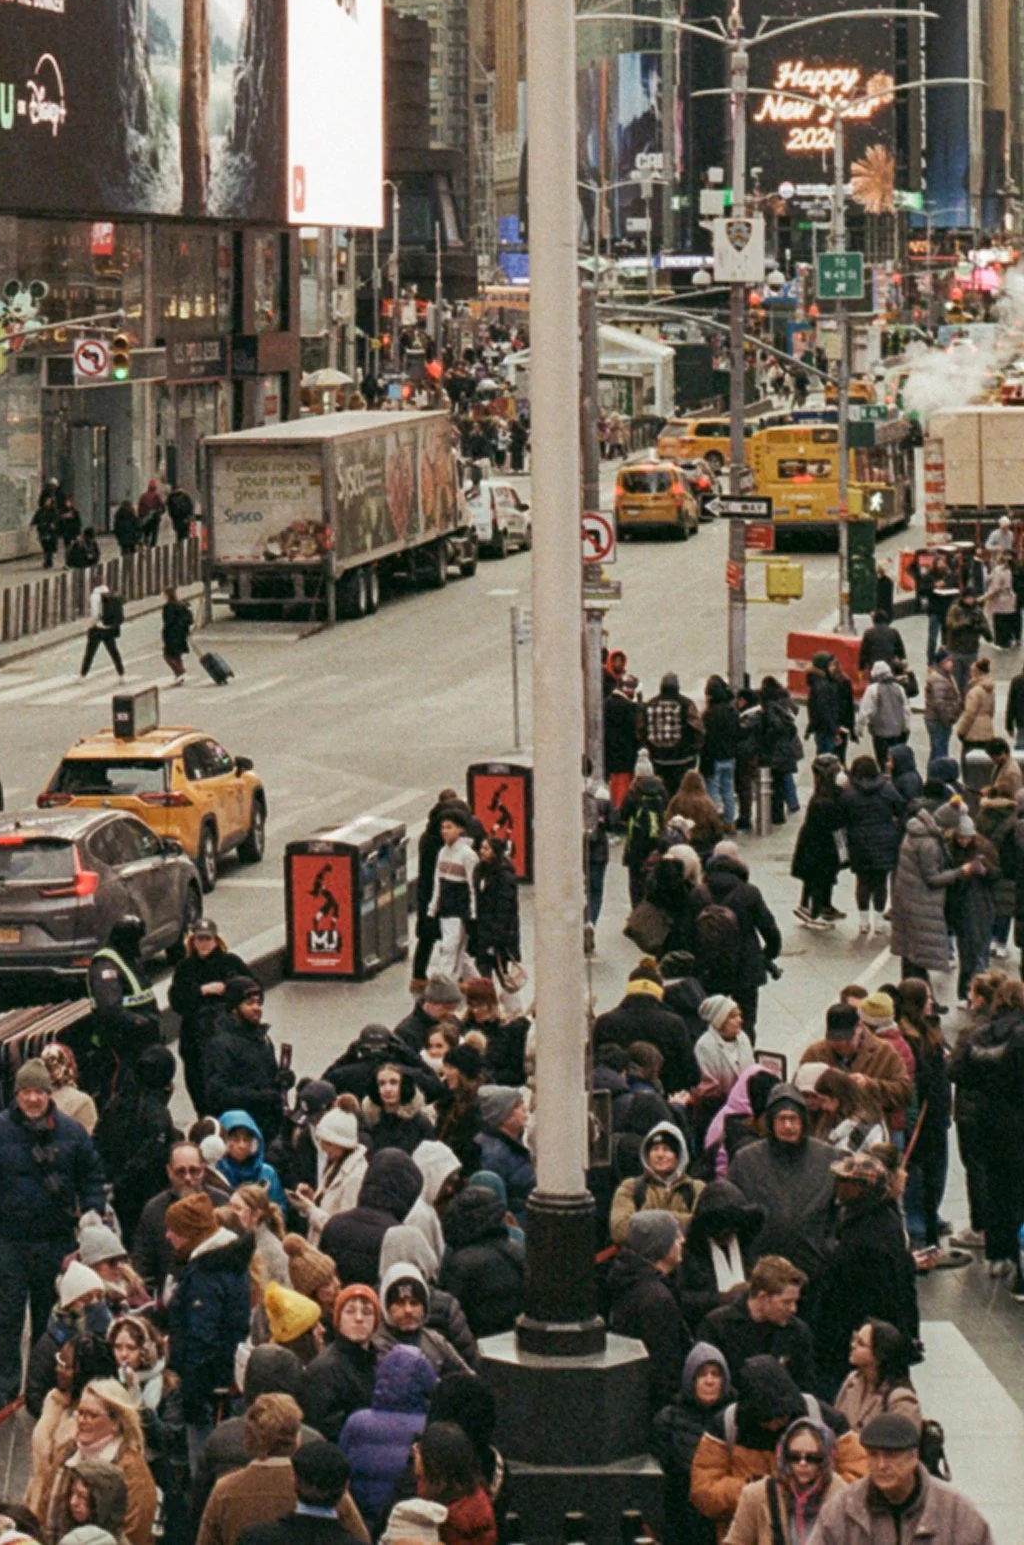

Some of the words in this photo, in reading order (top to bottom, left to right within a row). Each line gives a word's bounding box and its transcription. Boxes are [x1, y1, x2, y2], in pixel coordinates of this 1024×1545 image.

[774, 60, 861, 94] Happy
[754, 94, 814, 121] New
[224, 507, 264, 525] Sysco
[310, 929, 339, 952] MJ
